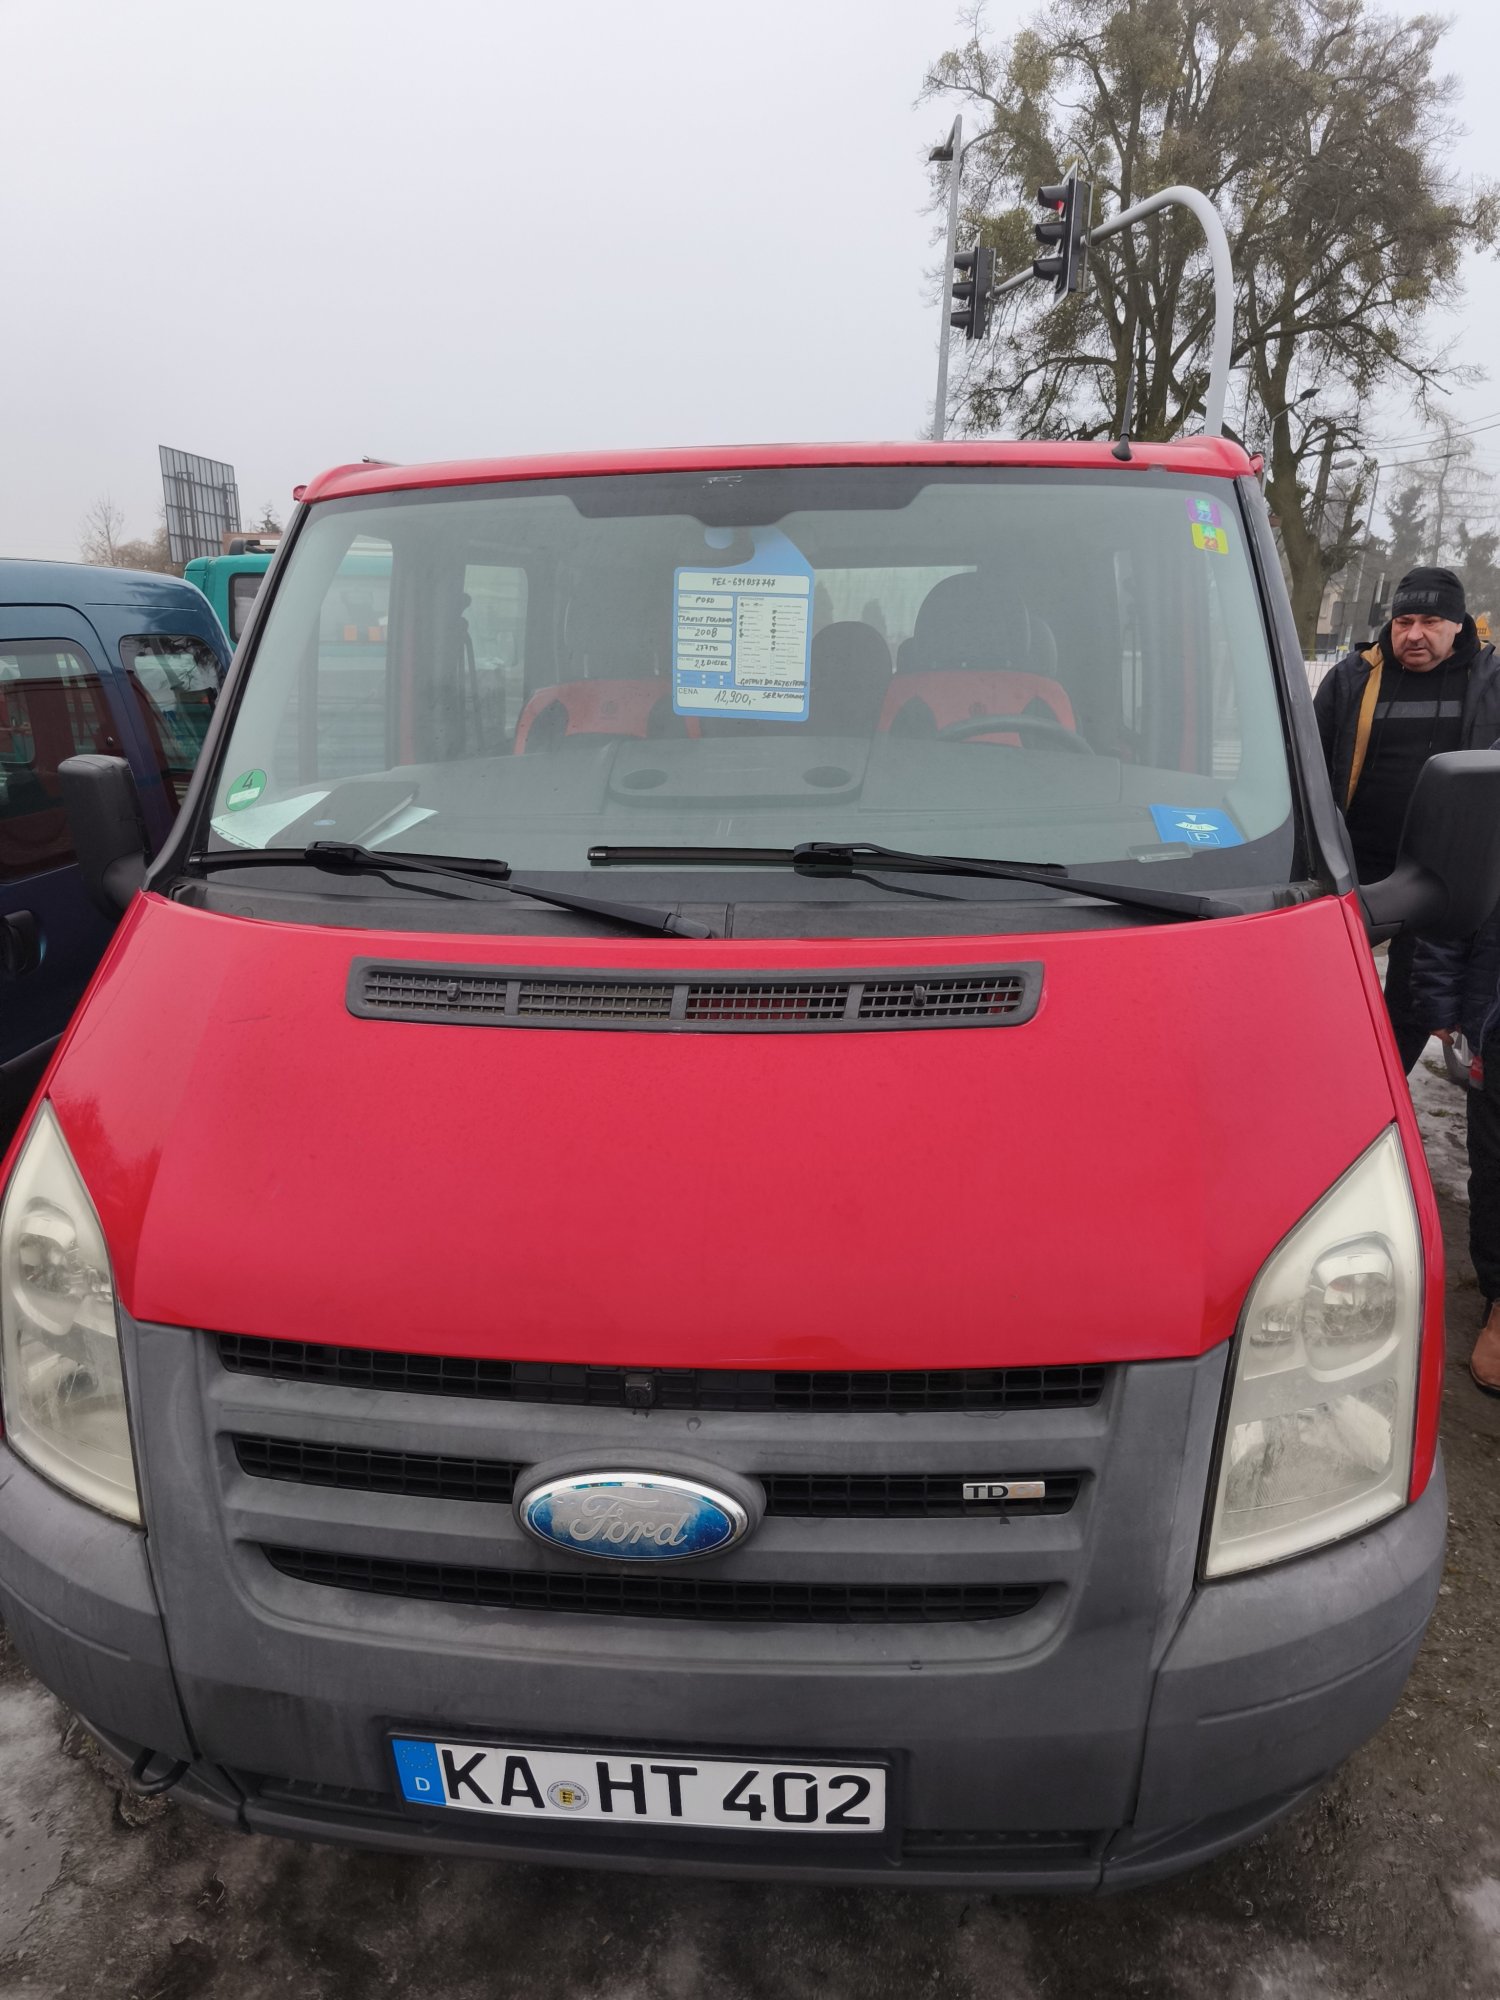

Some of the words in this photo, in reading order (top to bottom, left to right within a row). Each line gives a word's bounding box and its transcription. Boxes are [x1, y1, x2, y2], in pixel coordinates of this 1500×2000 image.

[694, 627, 718, 638] 2008
[678, 687, 699, 695] CENA
[242, 771, 255, 790] 4
[569, 1494, 690, 1546] Ford
[414, 1776, 431, 1791] D
[441, 1749, 546, 1809] KA
[595, 1761, 698, 1817] HT
[722, 1770, 872, 1825] 402
